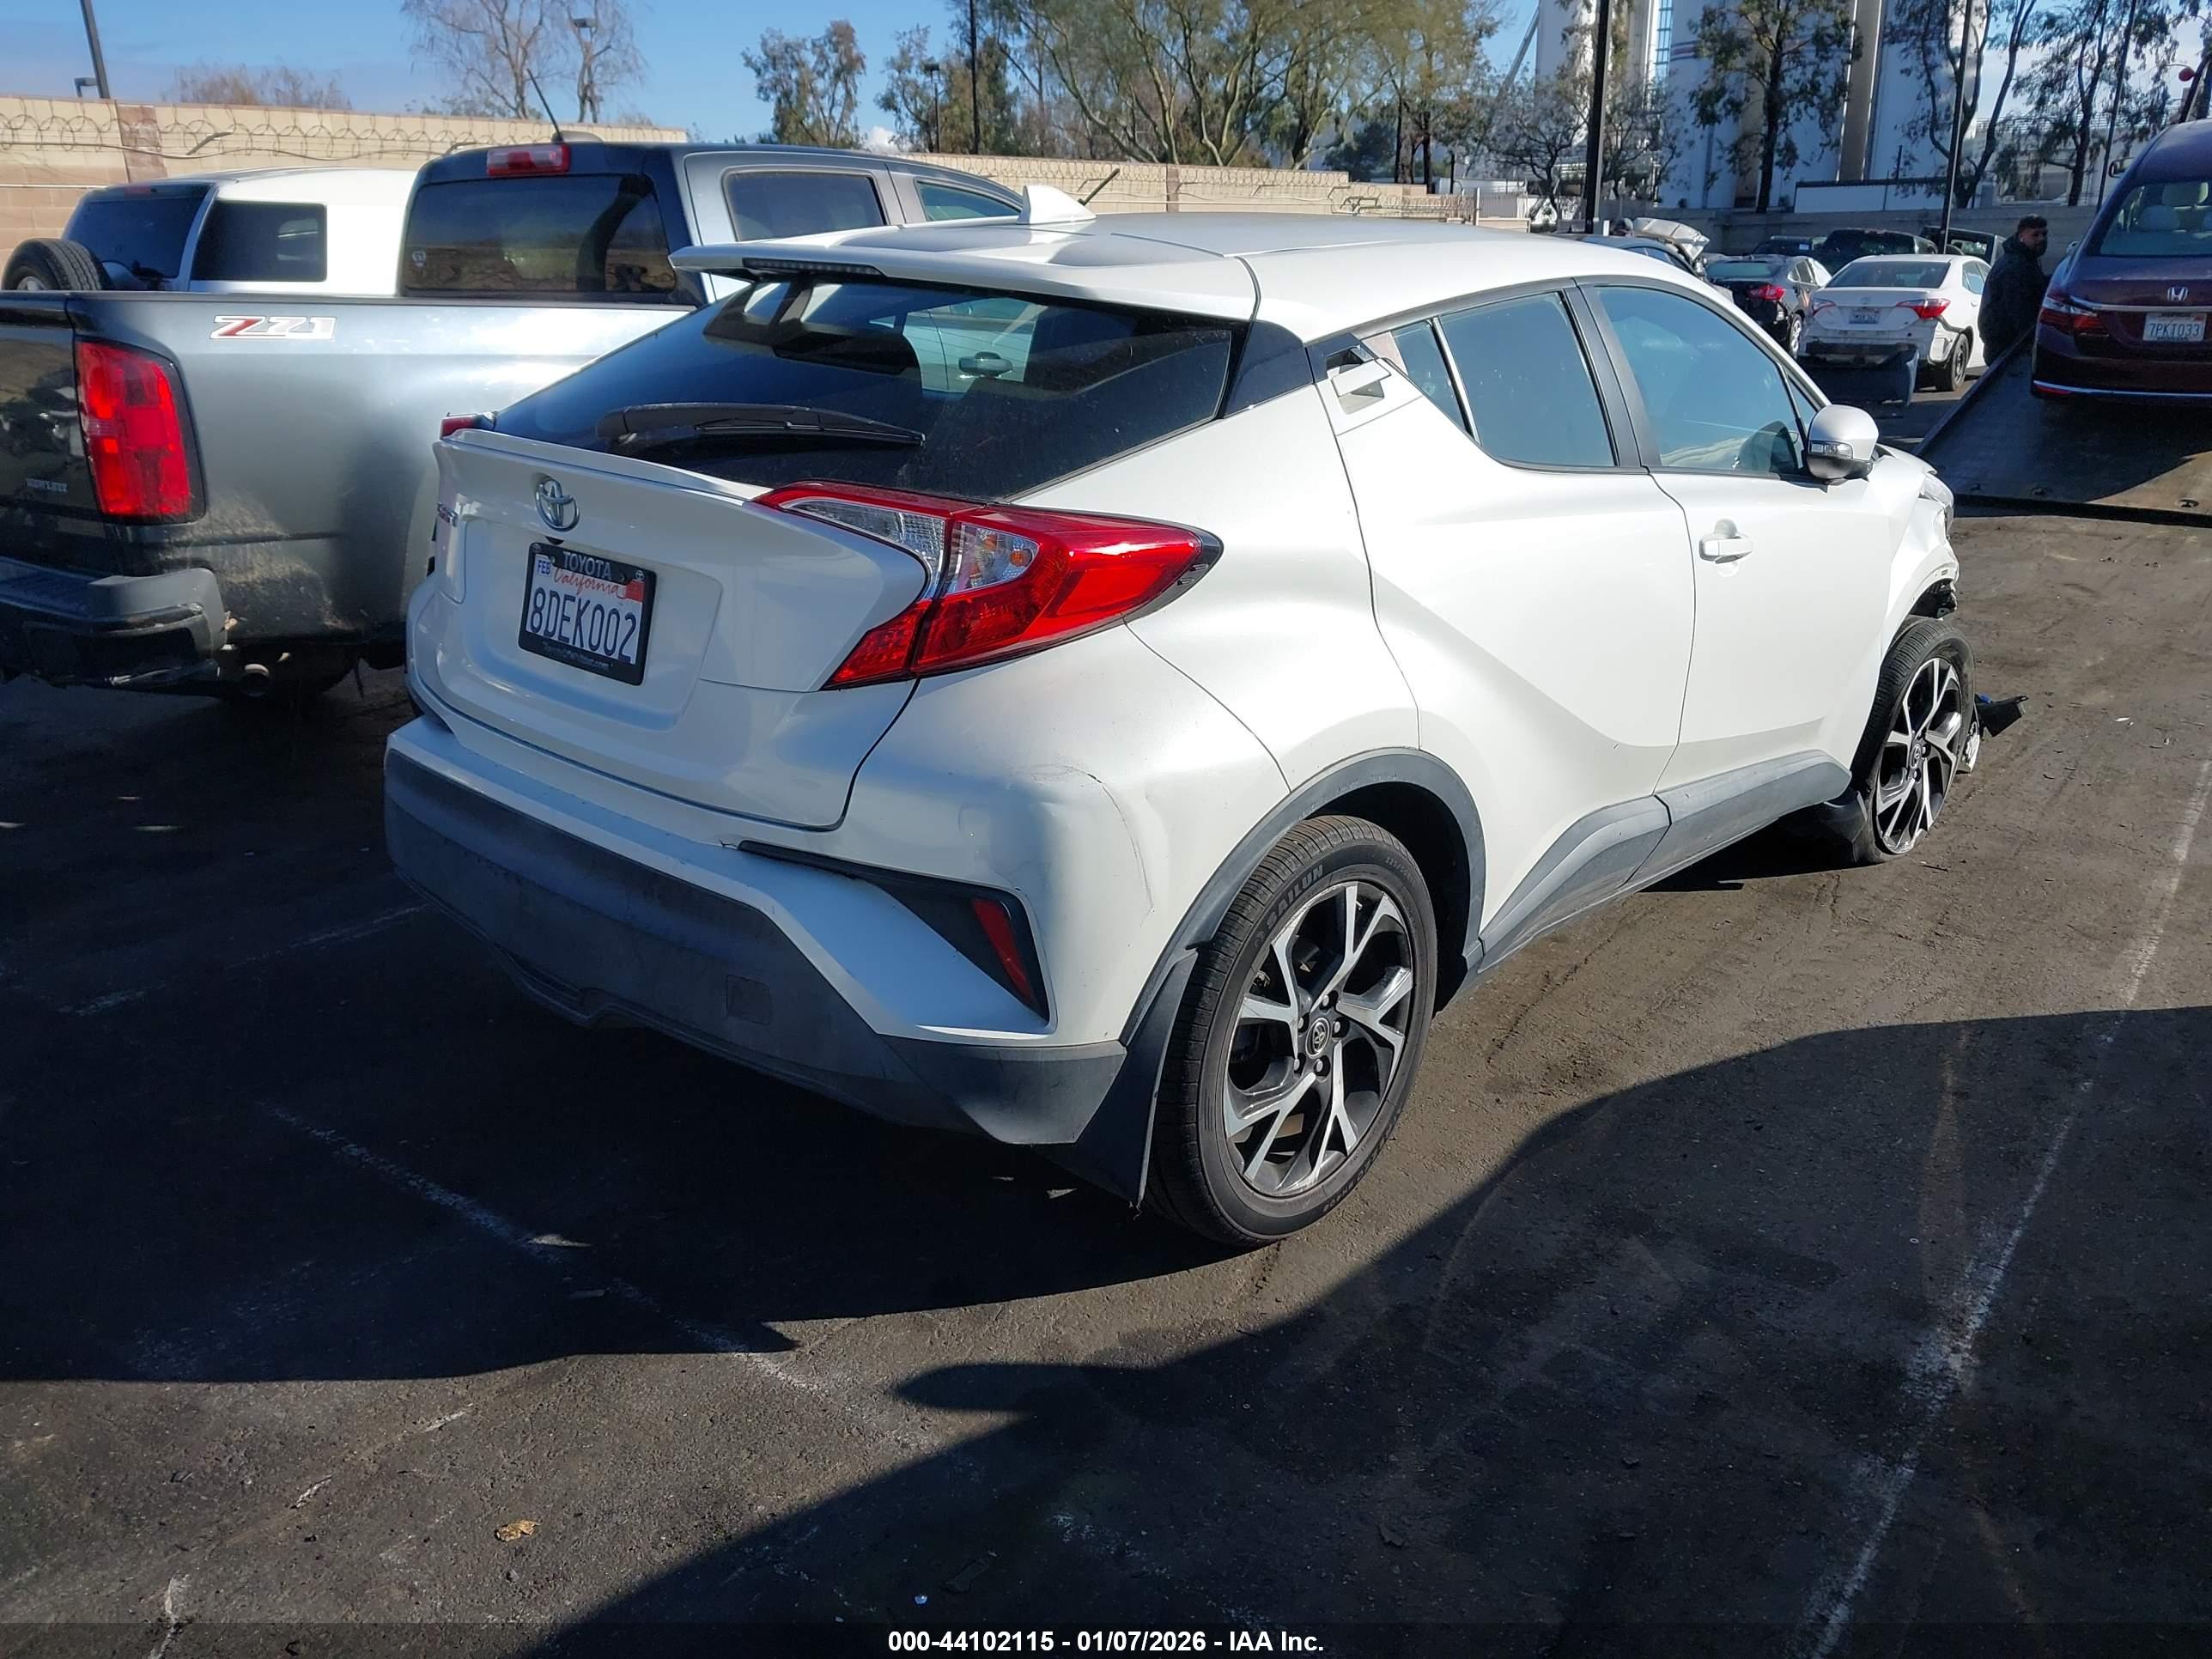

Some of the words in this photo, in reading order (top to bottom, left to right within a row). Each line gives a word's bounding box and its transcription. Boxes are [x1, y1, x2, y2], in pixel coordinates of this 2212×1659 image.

[210, 315, 337, 340] Z71
[536, 559, 551, 575] FEB
[562, 551, 612, 580] TOYOTA
[554, 568, 626, 599] California
[530, 587, 637, 664] 8DEK002
[1266, 864, 1324, 930] SAILUN
